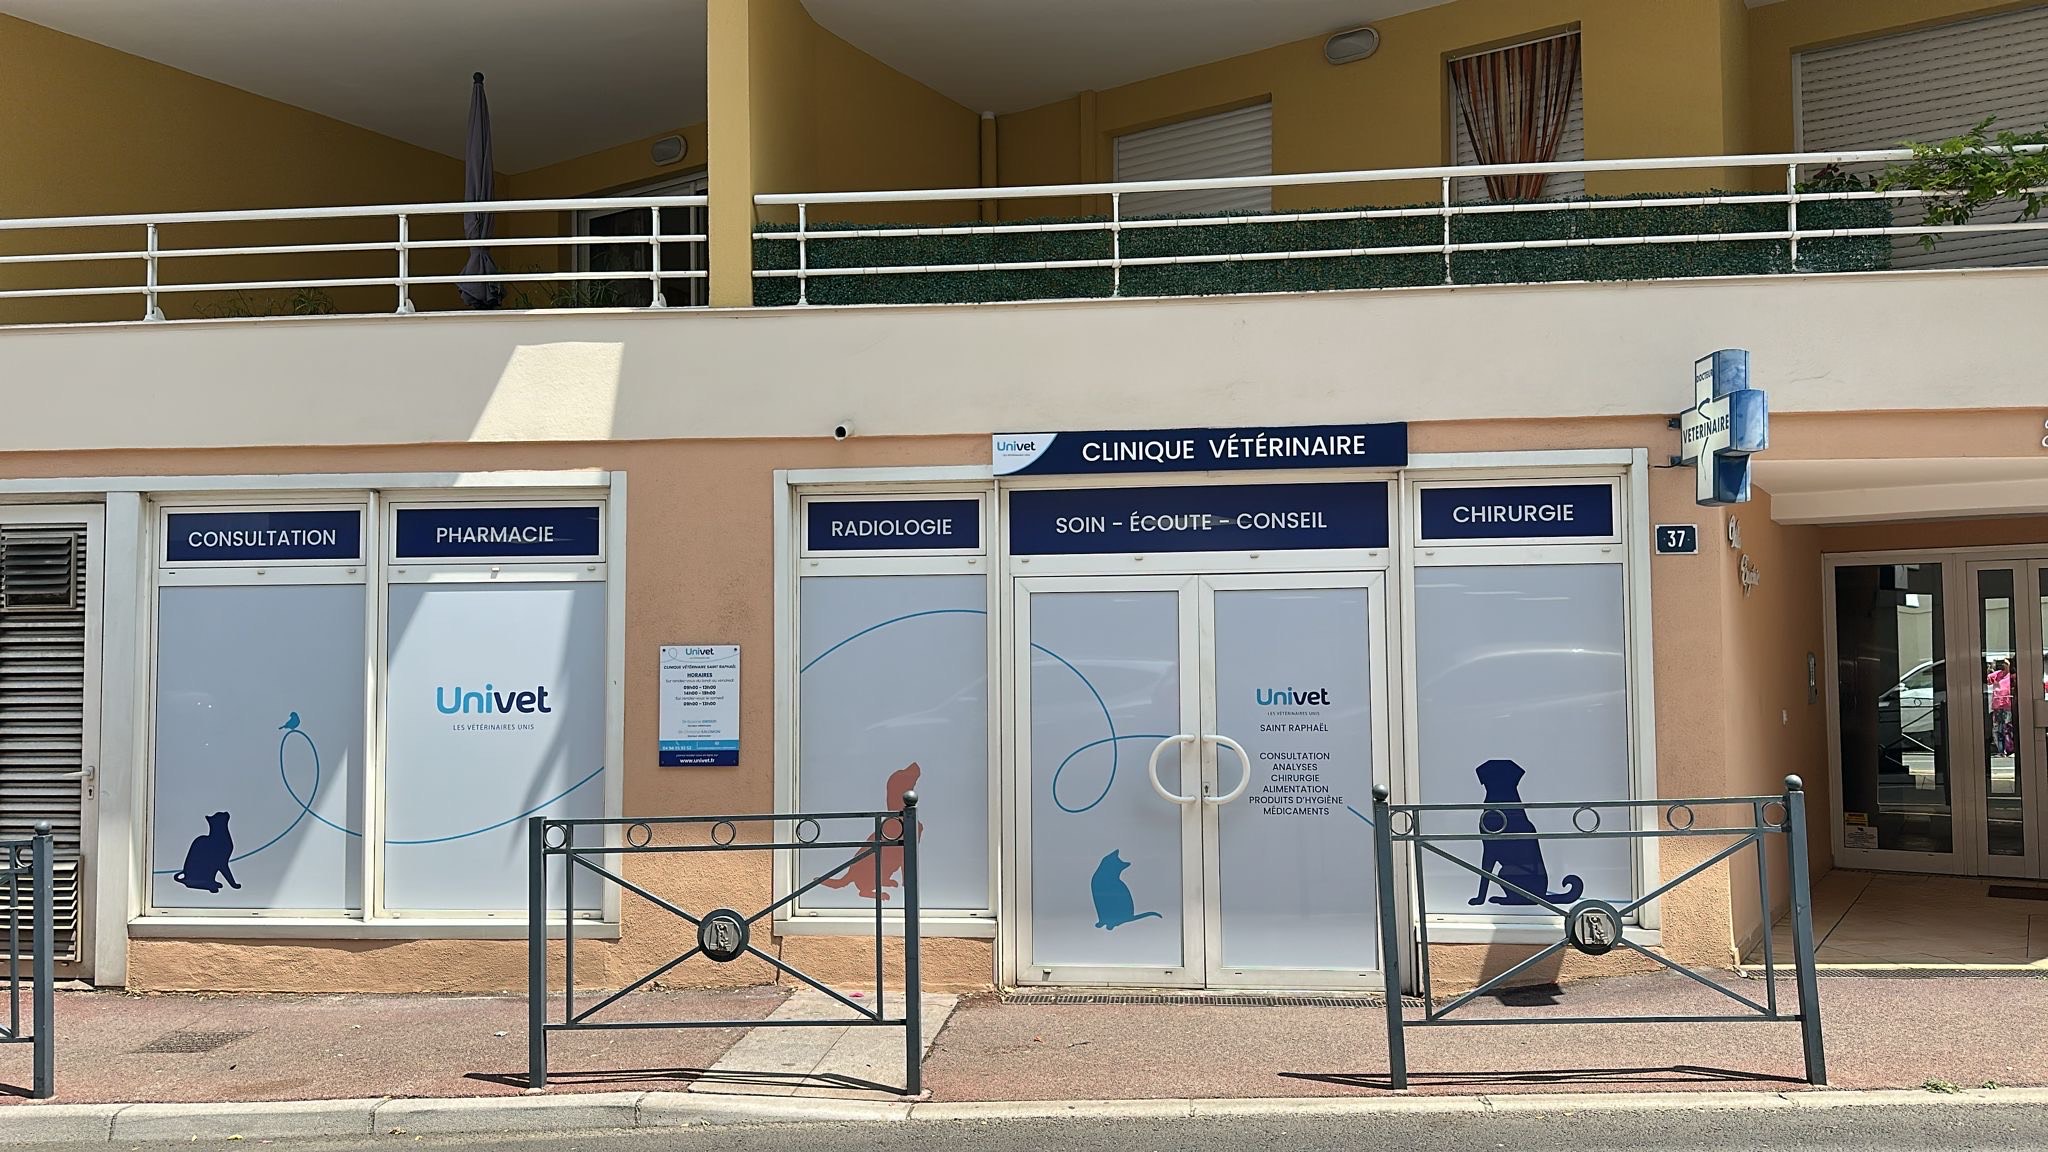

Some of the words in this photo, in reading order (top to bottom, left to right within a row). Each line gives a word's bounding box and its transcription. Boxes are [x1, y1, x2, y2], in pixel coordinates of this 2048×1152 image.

[1682, 414, 1730, 444] VETERINAIRE
[996, 440, 1036, 451] Univet
[1082, 440, 1195, 463] CLINIQUE
[1208, 432, 1366, 459] VÉTÉRINAIRE
[1056, 516, 1106, 534] SOIN
[1130, 511, 1212, 532] ÉCOUTE
[1236, 511, 1327, 530] CONSEIL
[1452, 504, 1574, 523] CHIRURGIE
[436, 526, 554, 544] PHARMACIE
[832, 519, 953, 537] RADIOLOGIE
[188, 529, 336, 548] CONSULTATION
[1667, 530, 1686, 548] 37
[686, 648, 714, 656] Univet
[437, 683, 552, 714] Univet
[1256, 687, 1331, 706] Univet
[1260, 724, 1286, 732] SAINT
[1288, 723, 1329, 732] RAPHAËL
[1260, 752, 1330, 760] CONSULTATION
[1272, 763, 1318, 771] ANALYSES
[1271, 774, 1320, 782] CHIRURGIE
[1263, 785, 1329, 793] ALIMENTATION
[1249, 796, 1294, 804] PRODUITS
[1296, 795, 1344, 804] D'HYGIÈNE
[1263, 806, 1330, 815] MÉDICAMENTS
